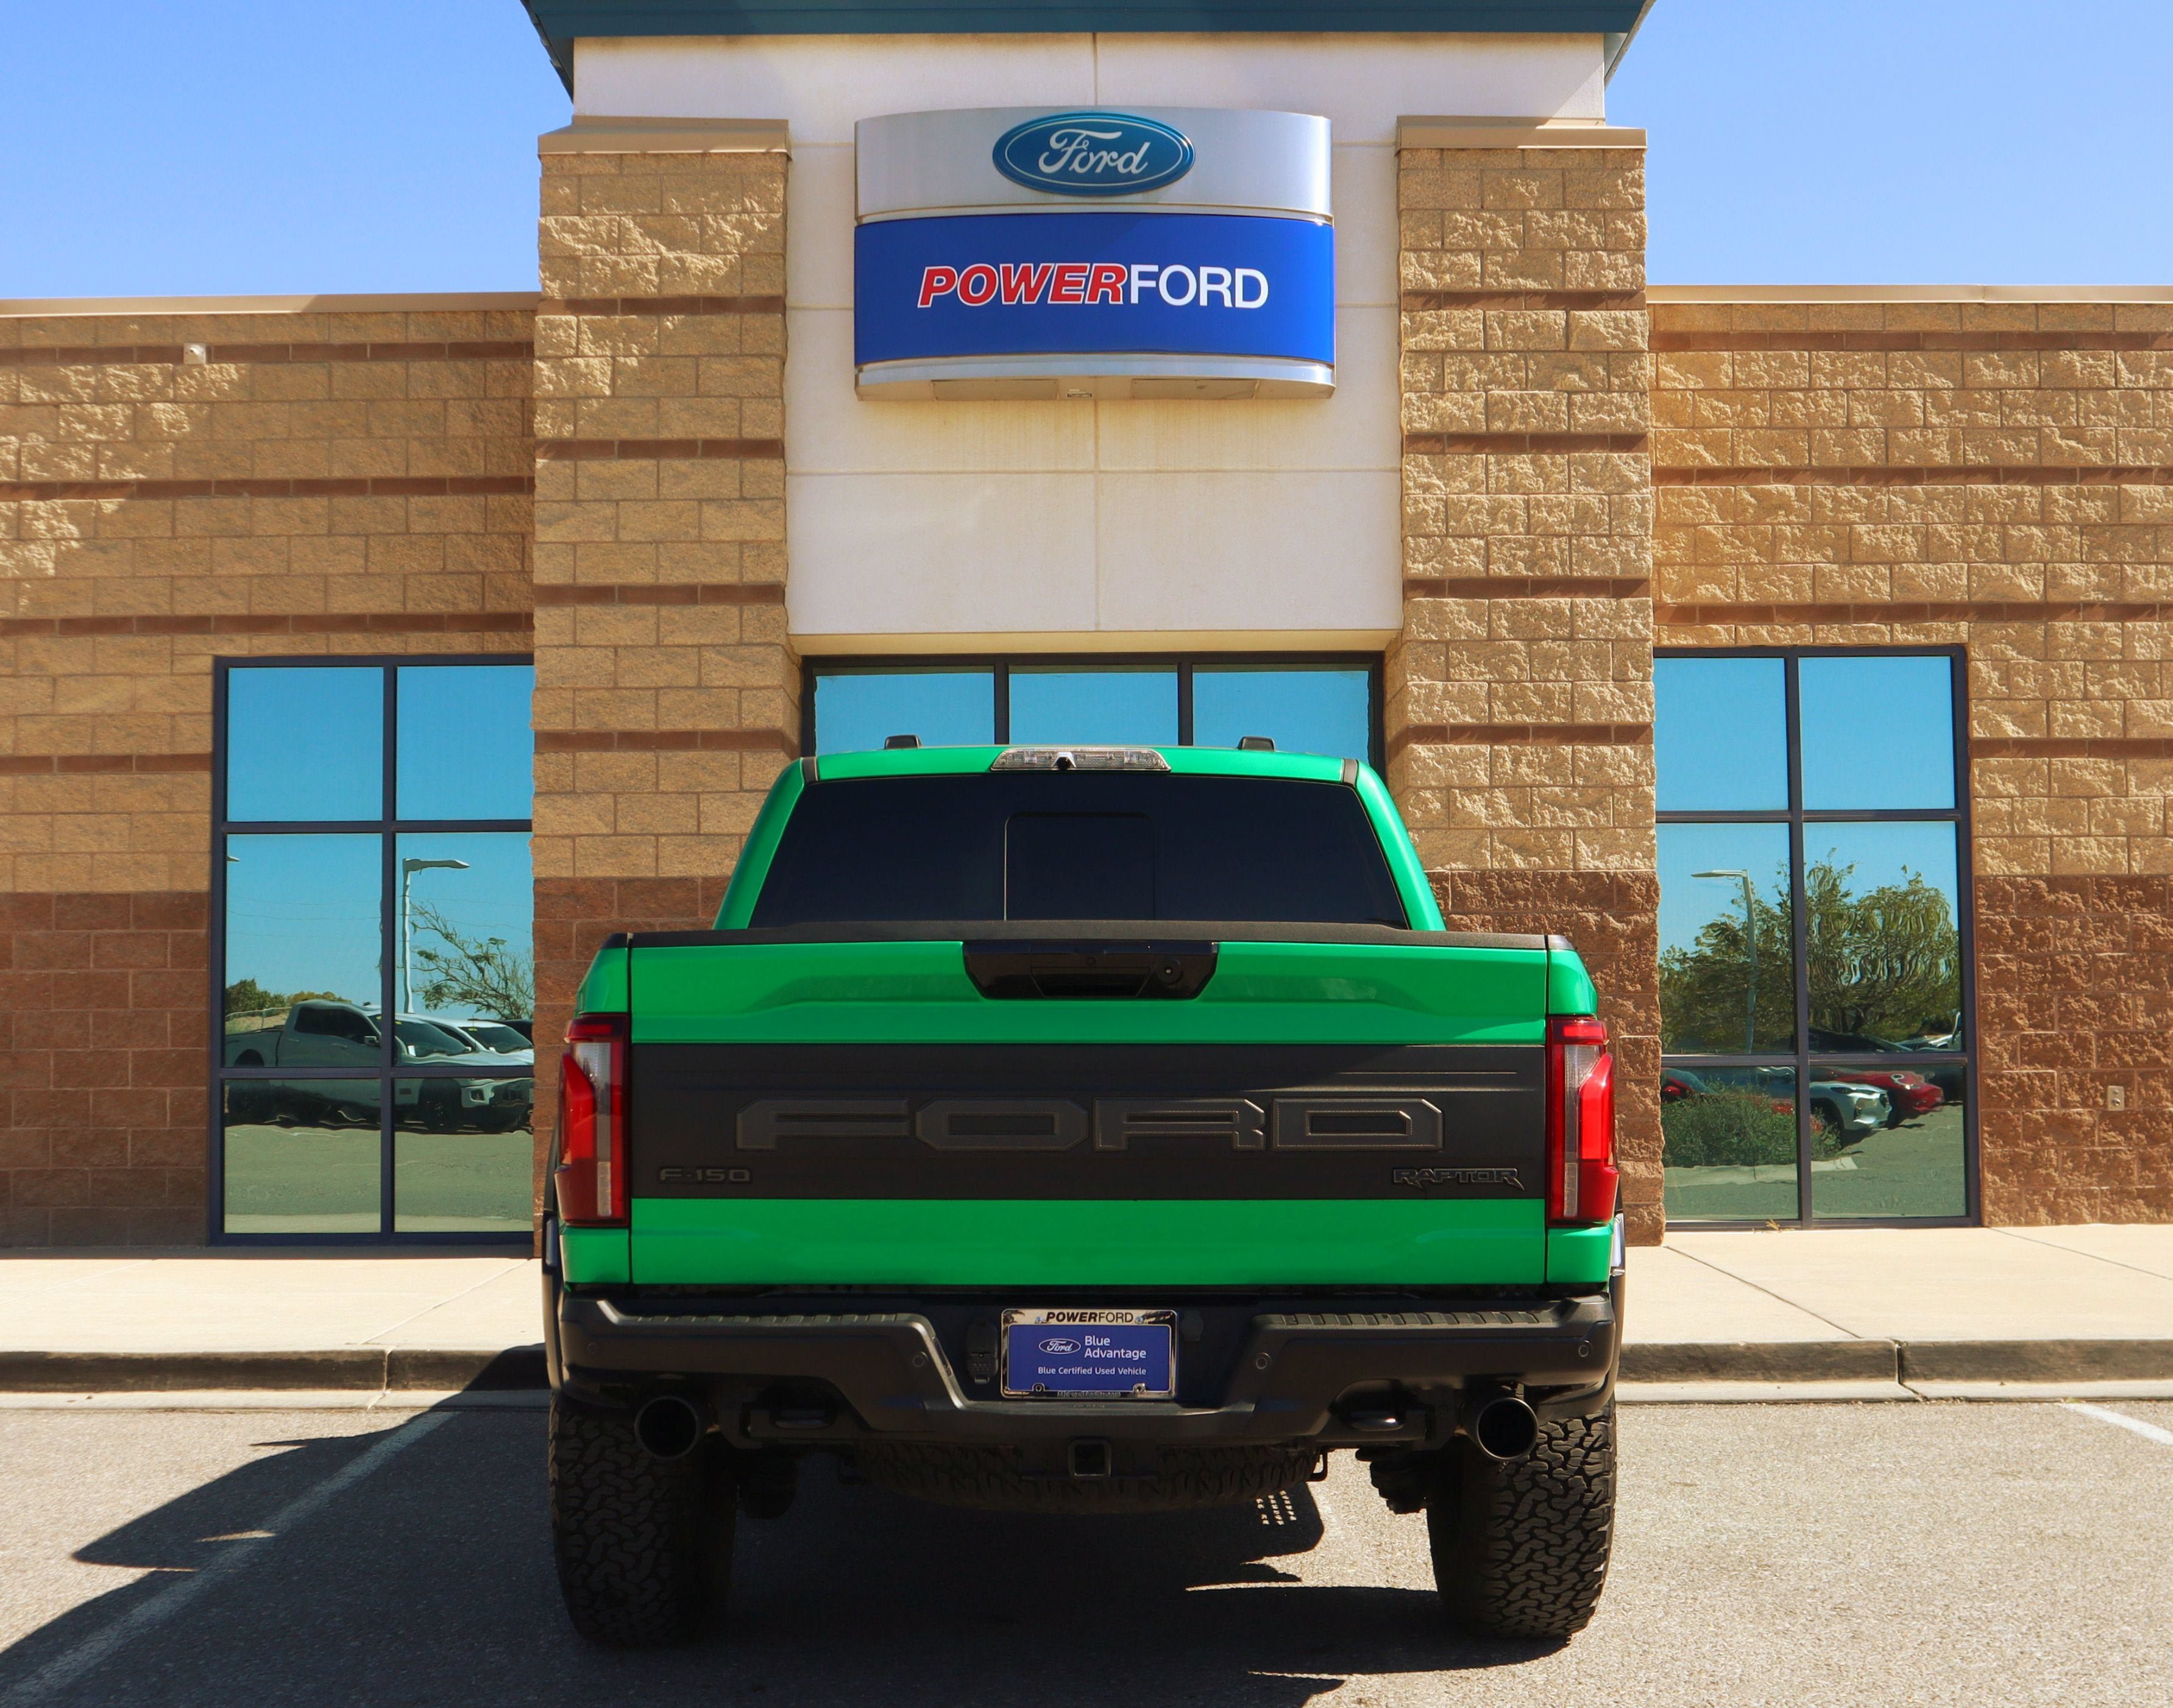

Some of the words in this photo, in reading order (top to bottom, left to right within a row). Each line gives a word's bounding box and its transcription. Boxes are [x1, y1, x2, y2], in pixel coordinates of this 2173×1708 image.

[1038, 128, 1149, 175] Ford
[917, 263, 1269, 309] POWERFORD
[736, 1098, 1443, 1152] FORD
[659, 1168, 751, 1182] F-150
[1392, 1168, 1525, 1191] RAPTOR
[1046, 1311, 1134, 1324] POWERFORD
[1046, 1340, 1073, 1352] Ford
[1084, 1335, 1111, 1346] Blue
[1084, 1347, 1147, 1361] Advantage
[1038, 1366, 1056, 1375] Blue
[1058, 1366, 1093, 1375] Certified
